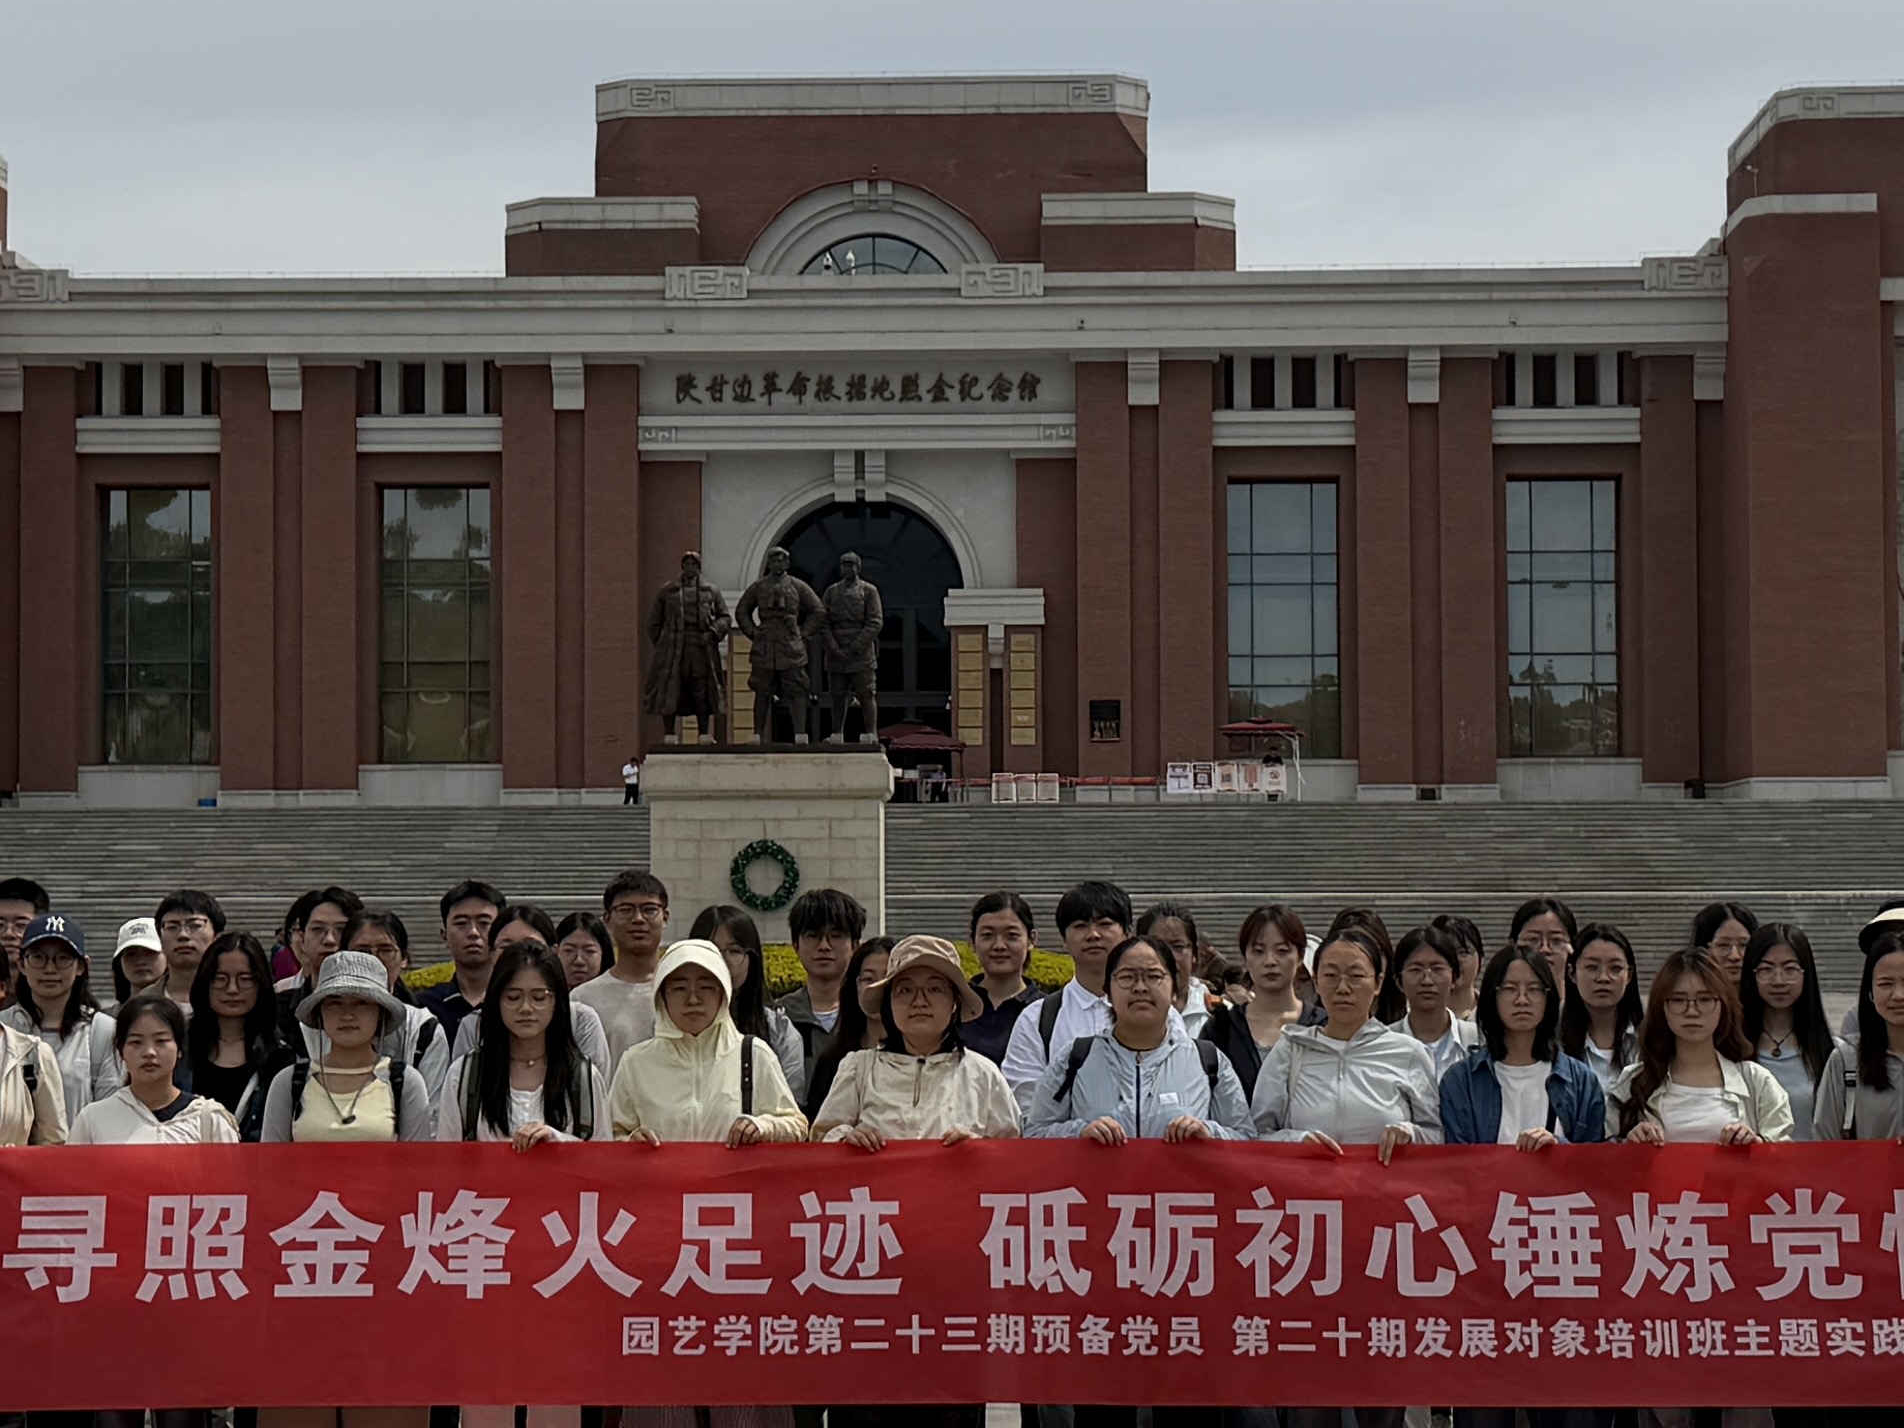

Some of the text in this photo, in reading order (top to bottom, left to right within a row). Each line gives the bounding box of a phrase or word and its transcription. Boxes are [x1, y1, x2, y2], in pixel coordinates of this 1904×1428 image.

[622, 1313, 1204, 1355] 园艺学院第二十三期预备党员
